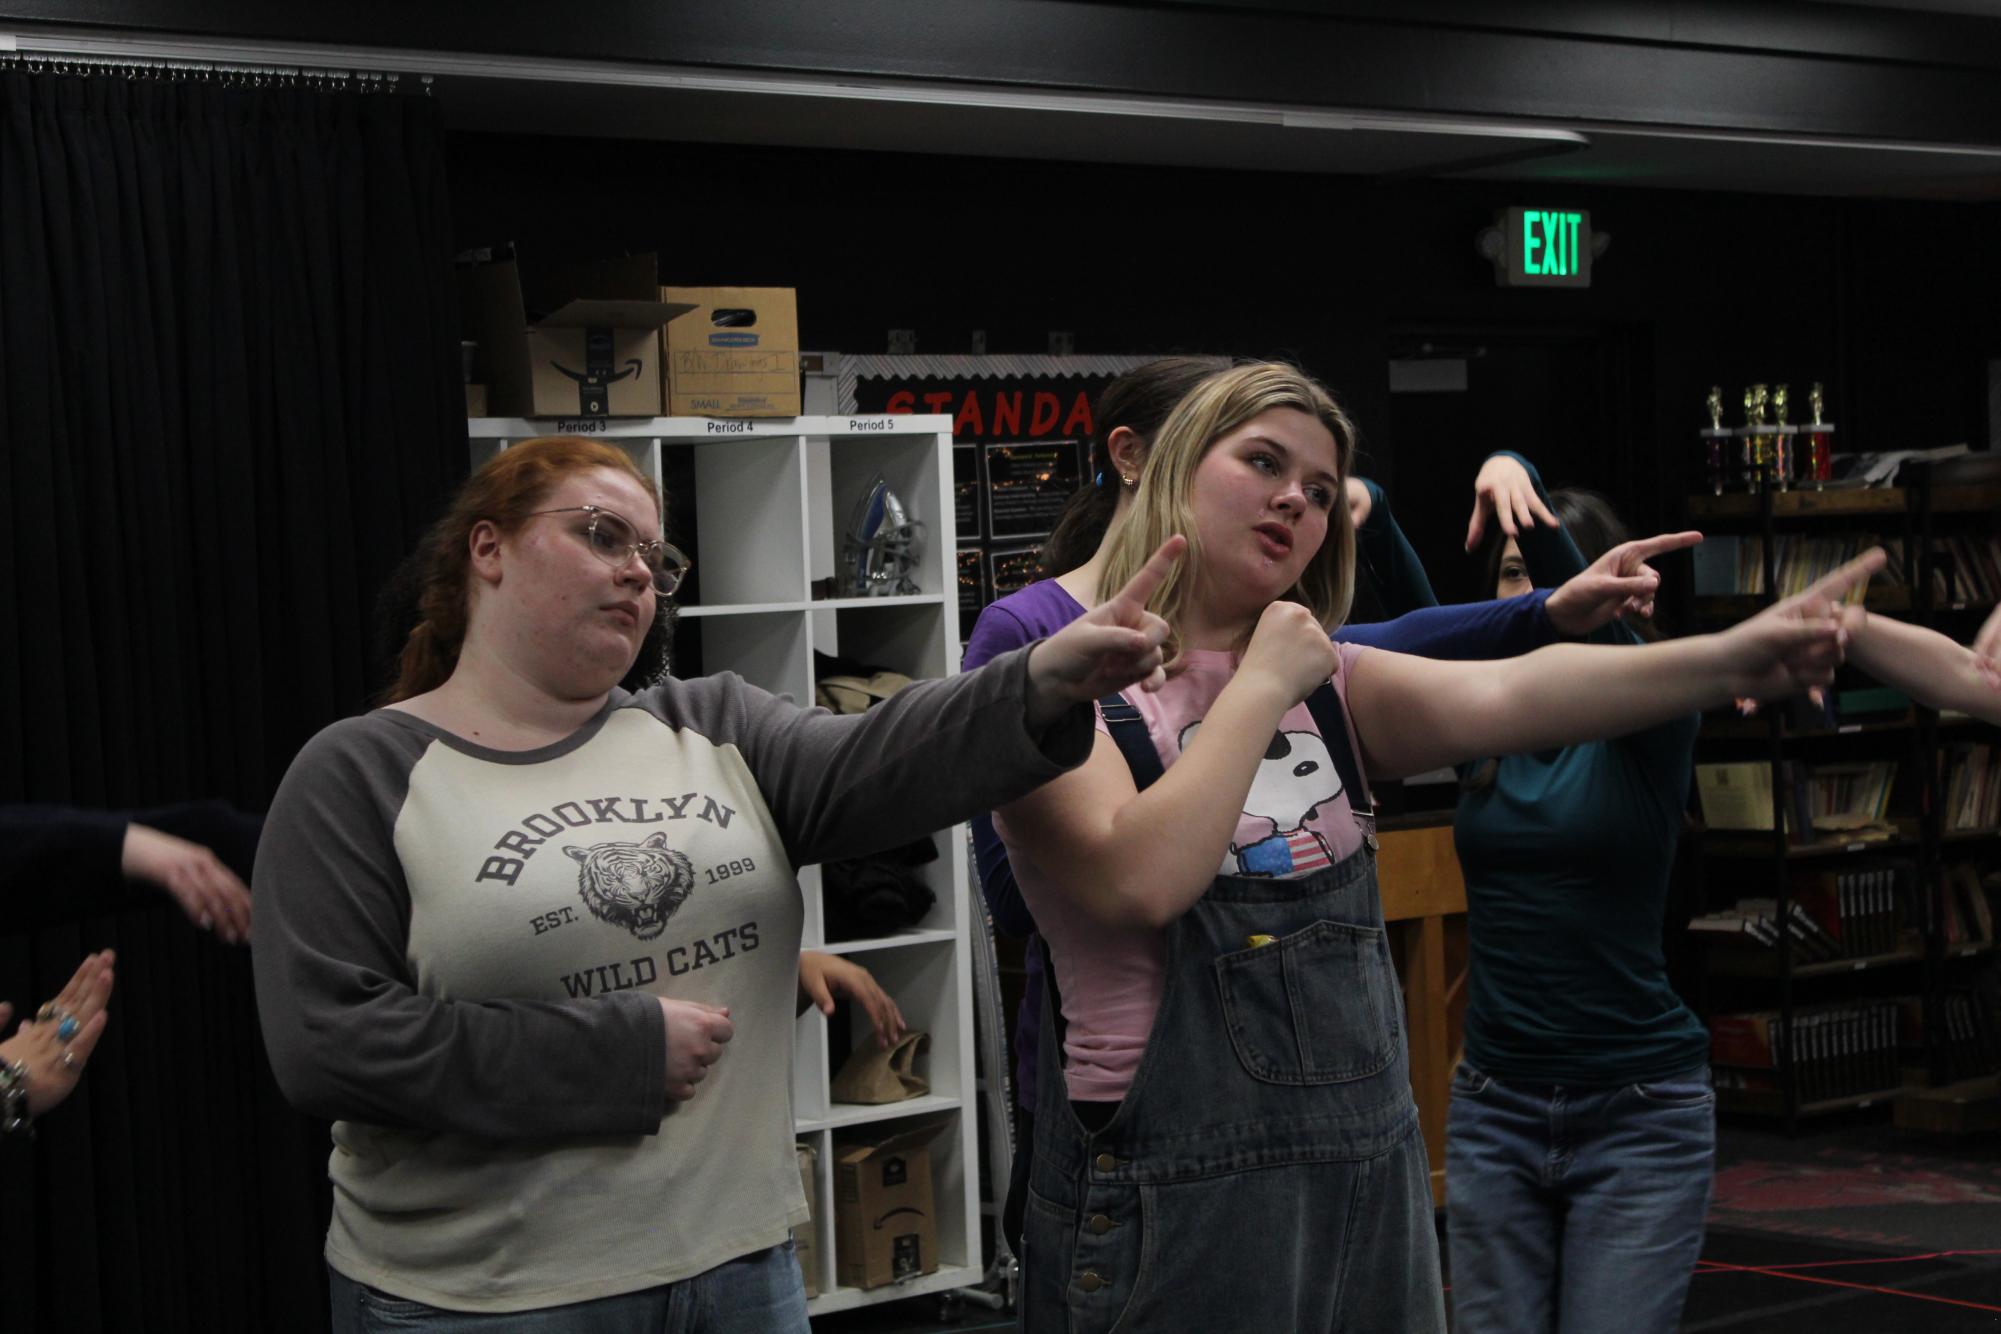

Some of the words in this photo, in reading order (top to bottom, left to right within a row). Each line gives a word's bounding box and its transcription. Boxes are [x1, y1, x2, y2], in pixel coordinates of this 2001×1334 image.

[1523, 210, 1582, 276] EXIT
[690, 399, 720, 409] SMALL
[558, 419, 596, 432] Period
[599, 419, 606, 432] 3
[707, 420, 744, 433] Period
[747, 420, 753, 431] 4
[850, 419, 884, 431] Period
[887, 419, 894, 430] 5
[475, 792, 736, 887] BROOKLYN
[705, 857, 756, 885] 1999
[529, 906, 579, 936] EST.
[560, 956, 657, 999] WILD
[667, 921, 760, 976] CATS
